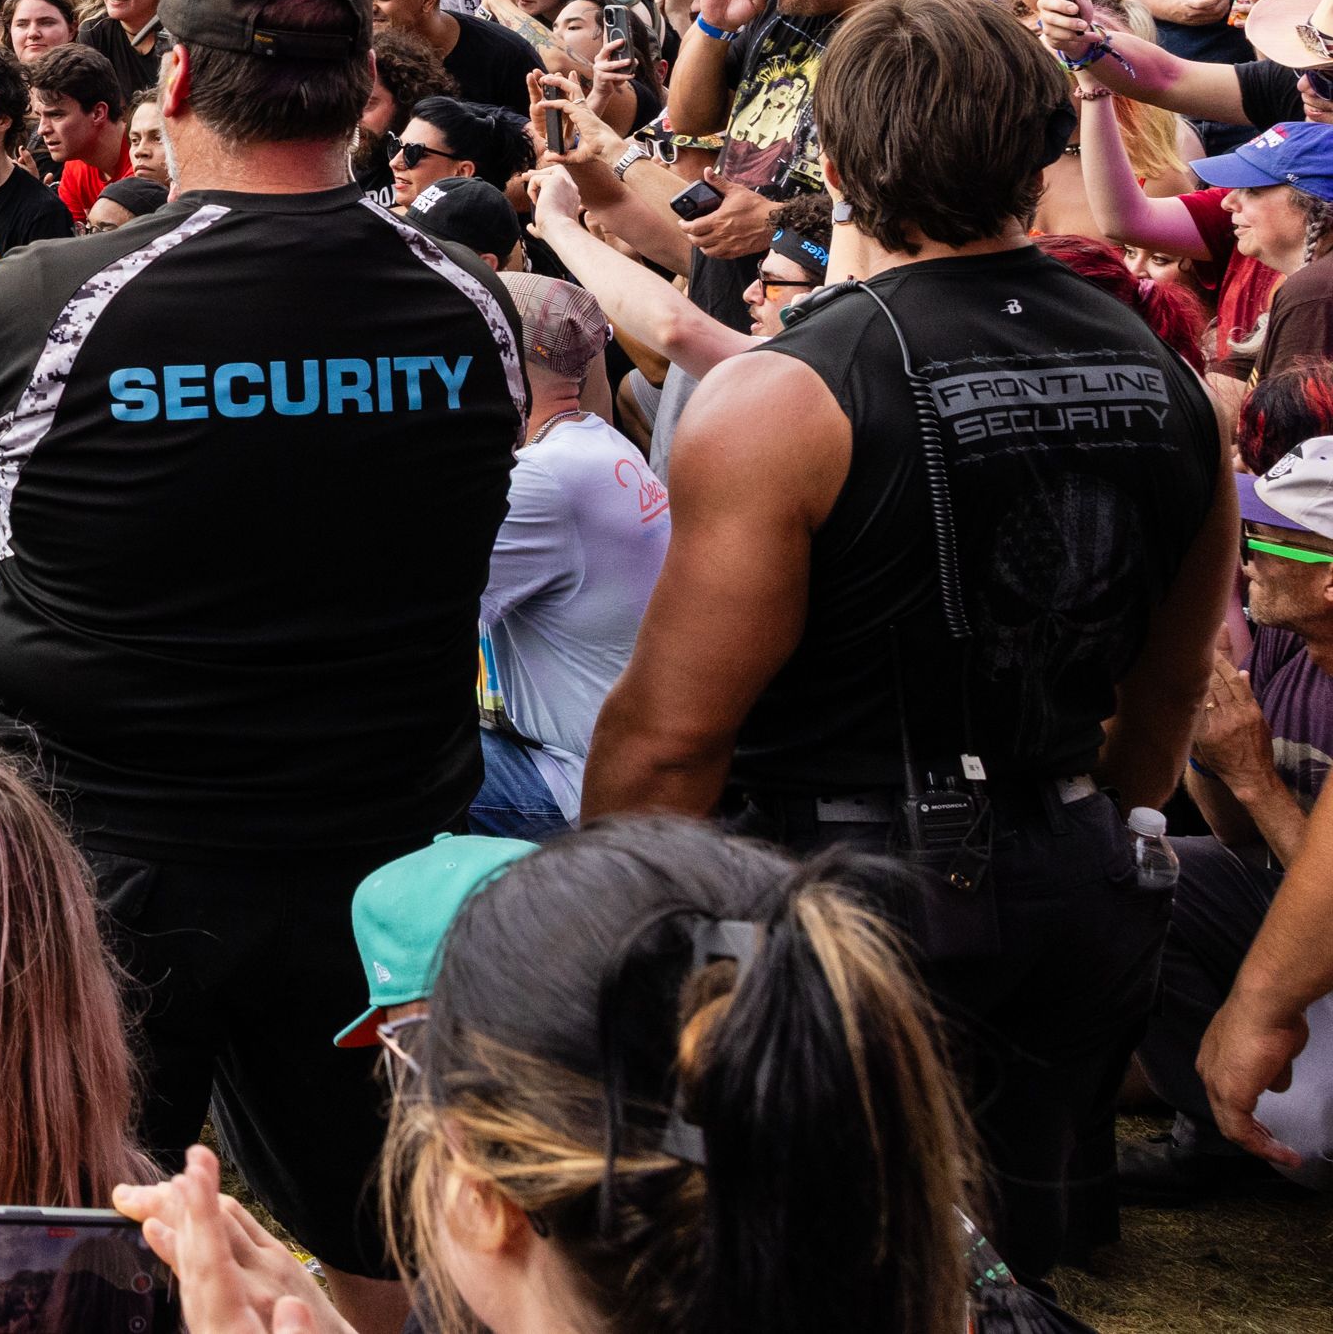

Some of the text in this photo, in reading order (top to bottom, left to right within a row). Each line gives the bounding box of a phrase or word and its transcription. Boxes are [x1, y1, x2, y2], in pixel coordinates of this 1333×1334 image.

[109, 354, 473, 422] SECURITY
[937, 370, 1164, 410] FRONTLINE
[952, 405, 1170, 445] SECURITY
[930, 802, 968, 811] MOTOROLA
